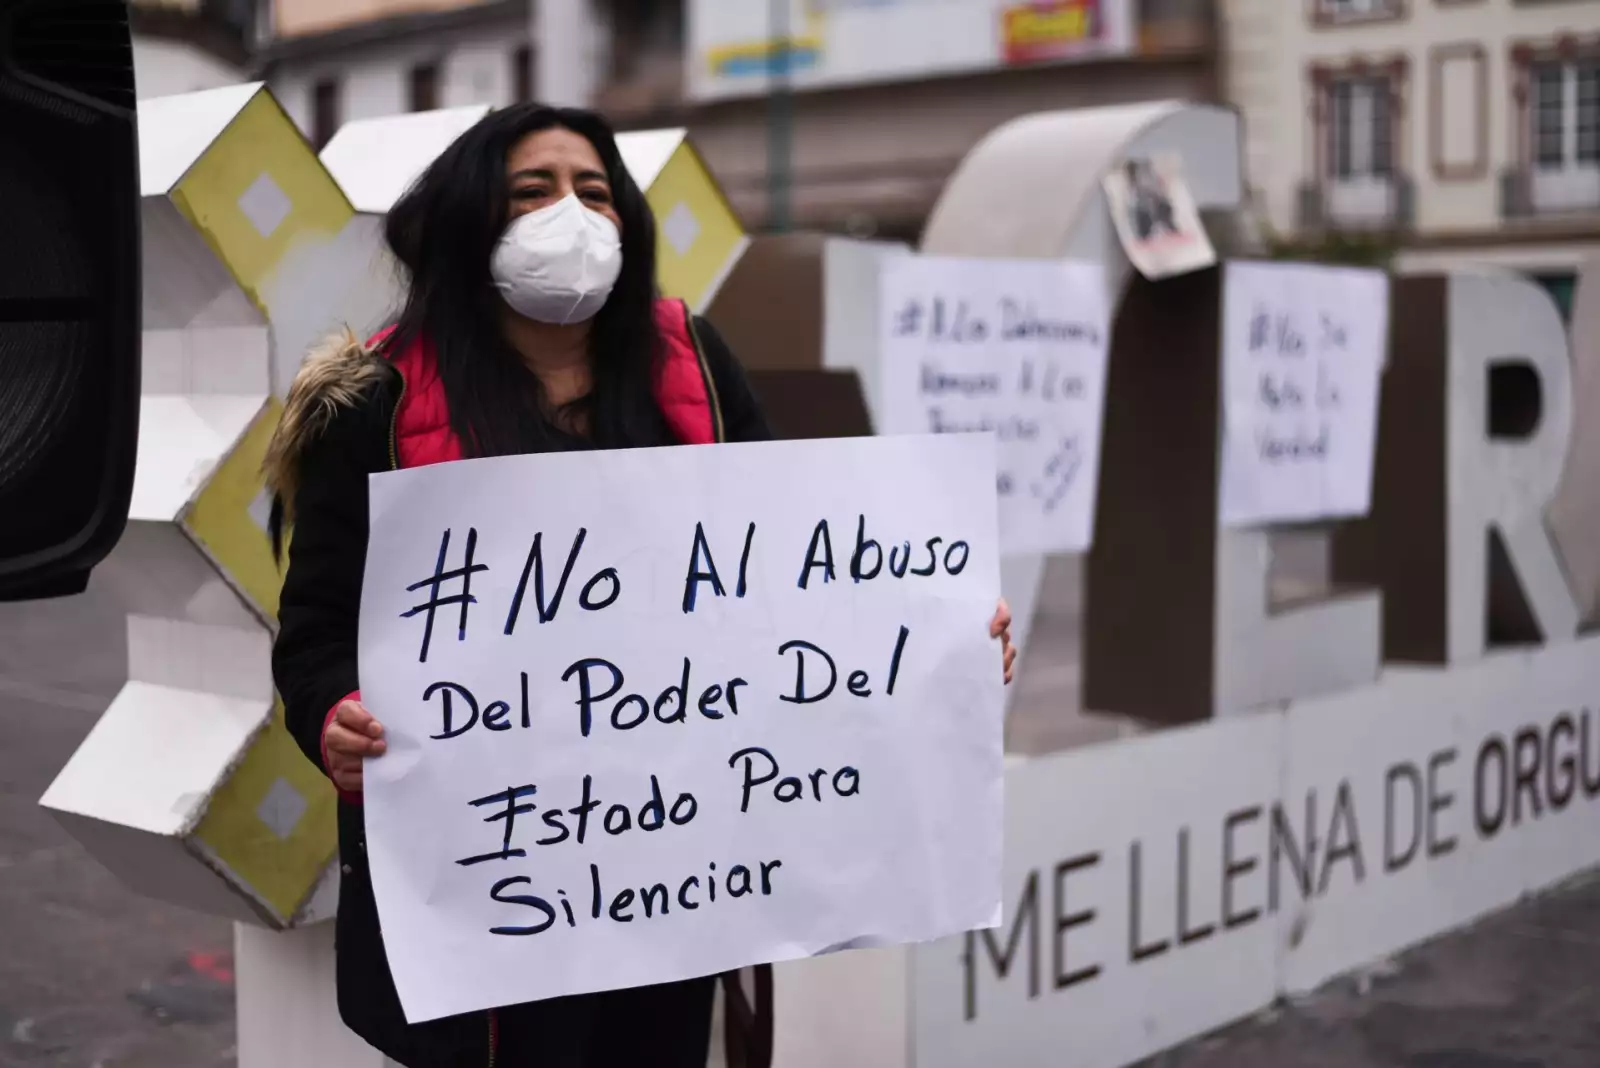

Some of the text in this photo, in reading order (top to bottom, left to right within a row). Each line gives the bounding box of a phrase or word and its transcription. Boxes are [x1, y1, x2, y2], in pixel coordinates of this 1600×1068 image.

[682, 521, 756, 615] Al
[797, 513, 971, 590] Abuso
[422, 624, 910, 740] Del Poder Del
[455, 746, 861, 867] Estado Para
[488, 858, 783, 937] Silenciar
[960, 850, 1104, 1022] ME
[1126, 776, 1366, 966] LLENA
[1383, 748, 1459, 874] DE
